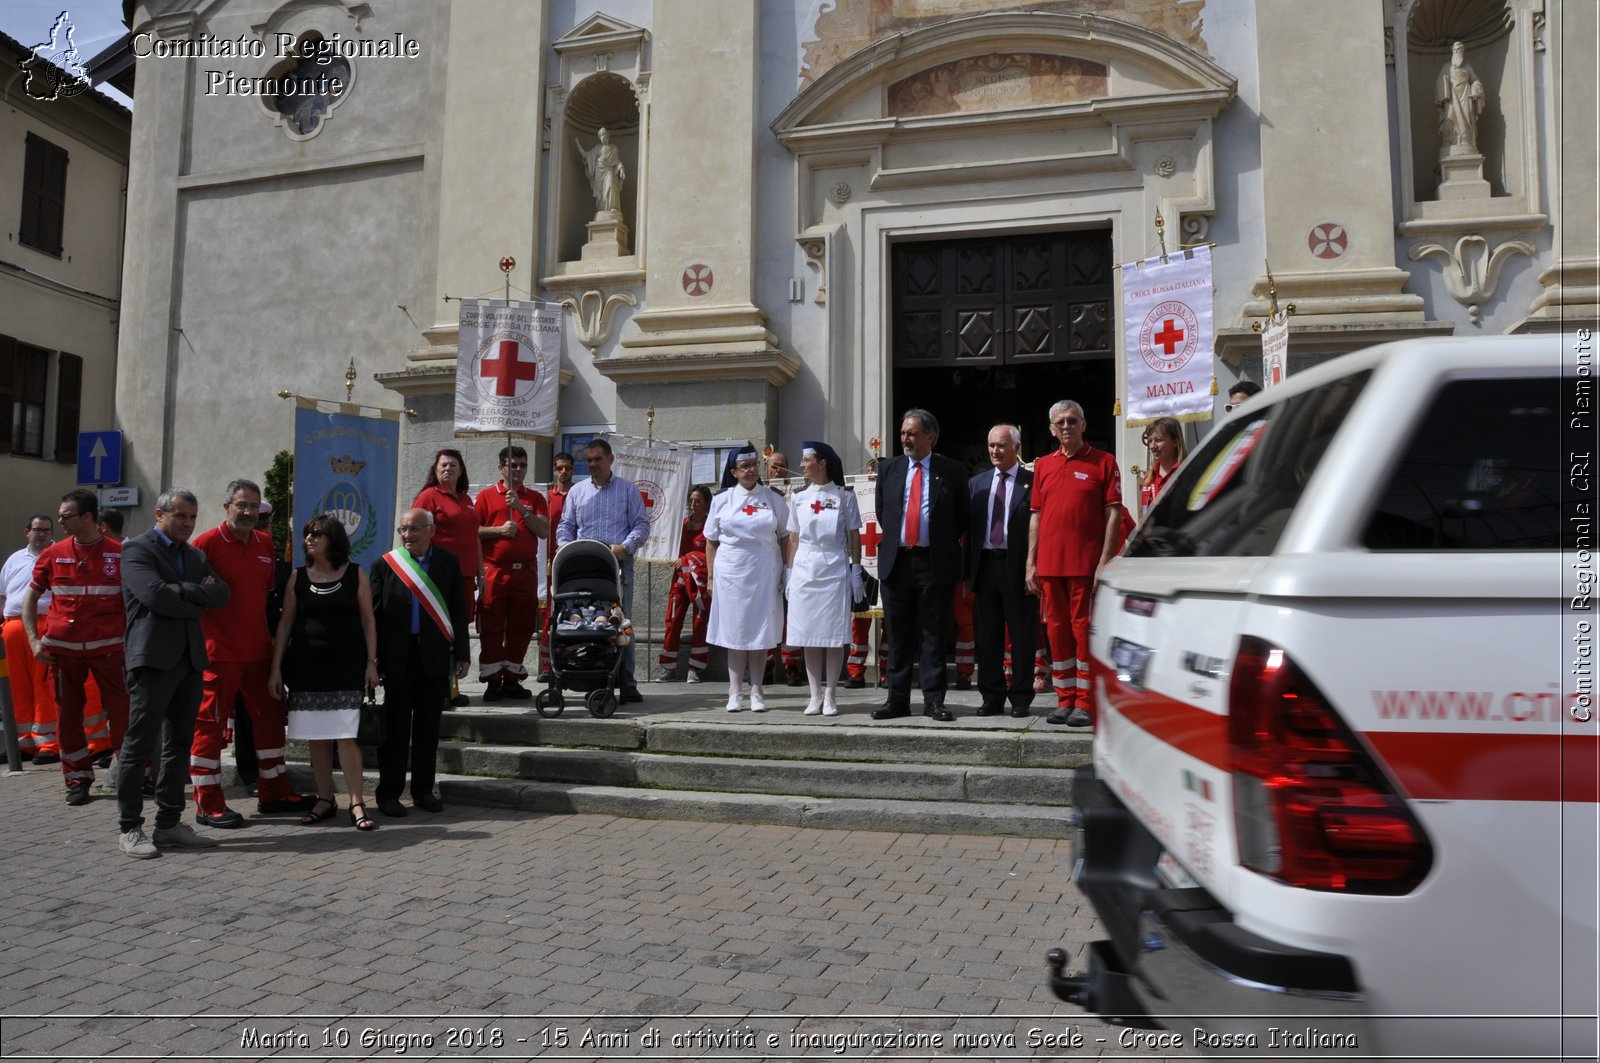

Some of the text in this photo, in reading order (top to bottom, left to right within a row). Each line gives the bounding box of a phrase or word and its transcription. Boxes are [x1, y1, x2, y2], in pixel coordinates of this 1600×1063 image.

[1130, 278, 1206, 299] CROCE ROSSA ITALIANA
[461, 319, 560, 333] CROCE ROSSA ITALIANA
[1146, 381, 1195, 398] MANTA
[471, 408, 541, 419] DELEGAZIONE DI
[473, 417, 537, 428] PEVERAGNO
[857, 487, 876, 496] ROSS
